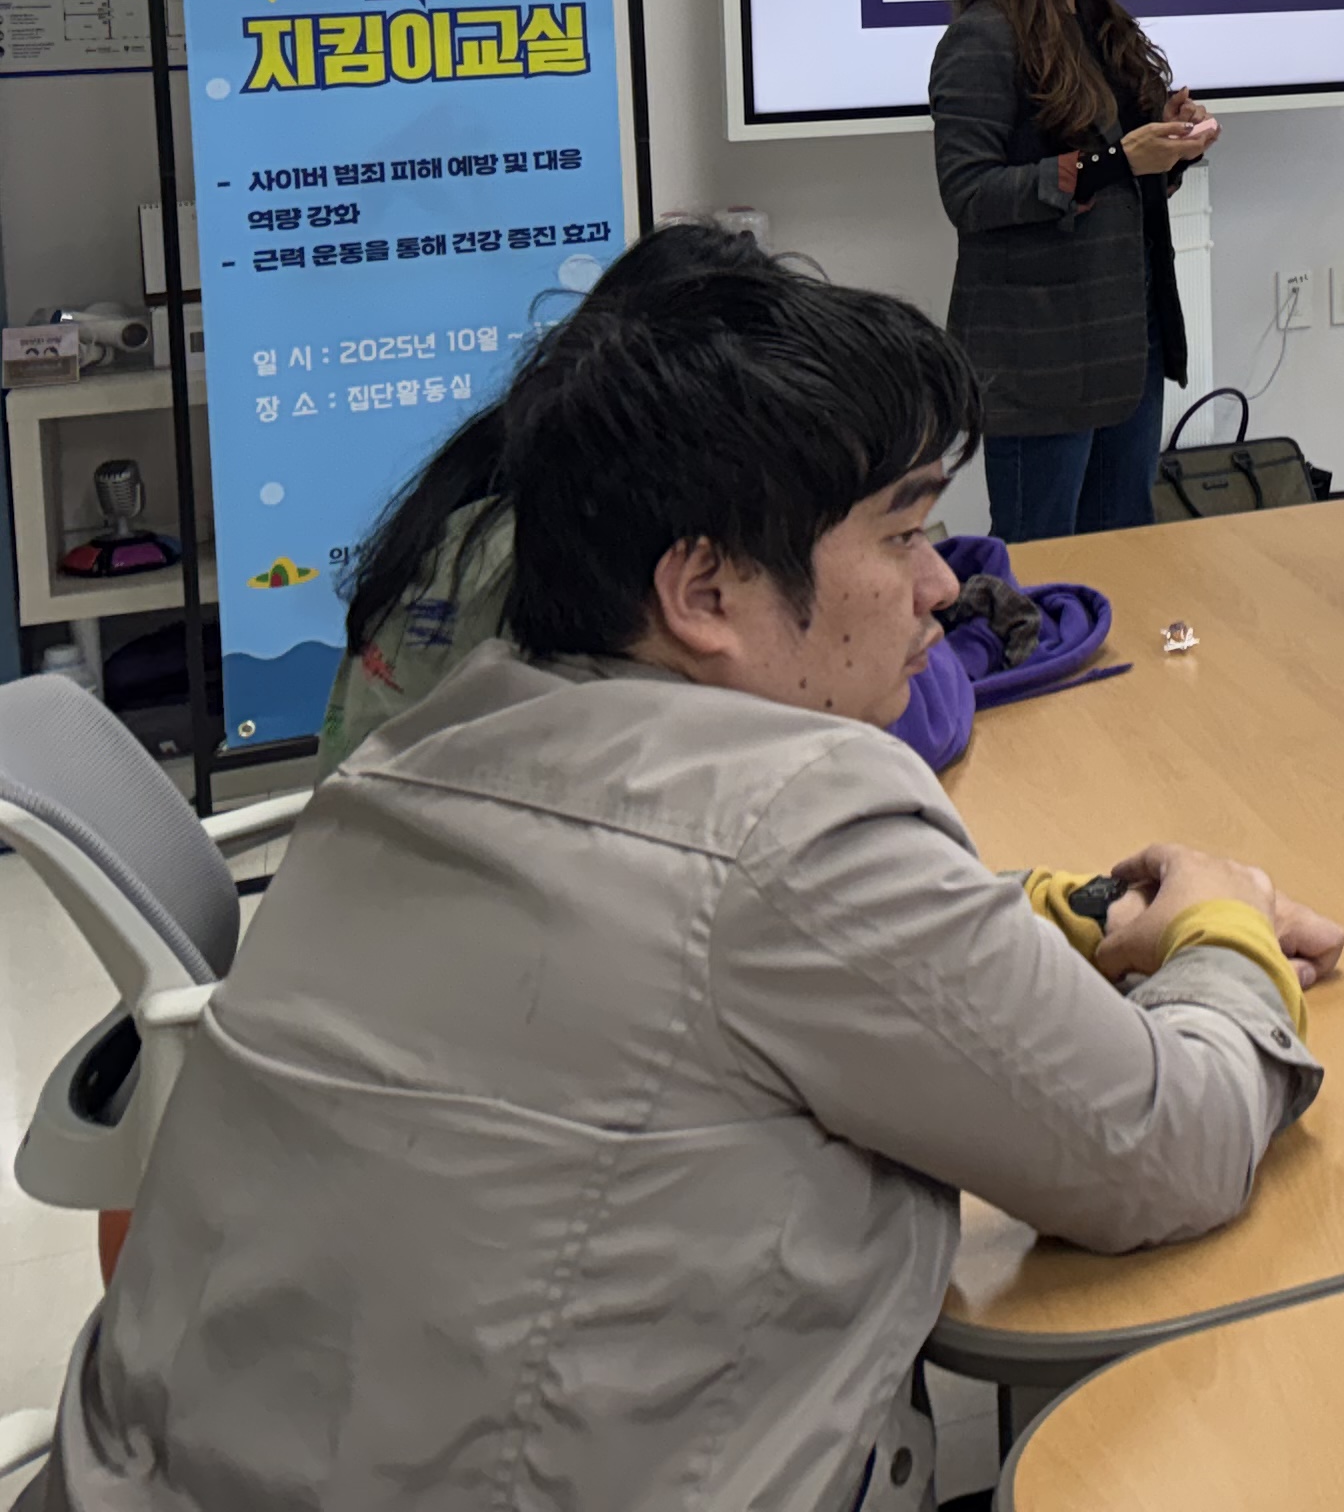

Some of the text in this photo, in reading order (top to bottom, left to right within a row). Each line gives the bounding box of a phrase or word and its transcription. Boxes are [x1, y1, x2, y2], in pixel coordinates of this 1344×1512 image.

[240, 4, 592, 92] 지킴이교실
[248, 166, 328, 193] 사이버
[333, 161, 385, 187] 범죄
[391, 158, 442, 182] 피해
[447, 153, 499, 179] 예방
[503, 151, 529, 175] 및
[533, 148, 583, 172] 대응
[247, 202, 361, 232] 역량 강화
[252, 247, 305, 273] 근력
[311, 239, 390, 267] 운동을
[395, 233, 447, 260] 통해
[452, 229, 502, 255] 건강
[507, 225, 557, 250] 증진
[561, 220, 612, 246] 효과
[253, 349, 278, 377] 일
[288, 345, 313, 371] 시
[339, 332, 436, 365] 2025년
[446, 325, 499, 352] 10월
[255, 395, 280, 423] 장
[291, 392, 319, 417] 소
[347, 373, 472, 412] 집단활동실
